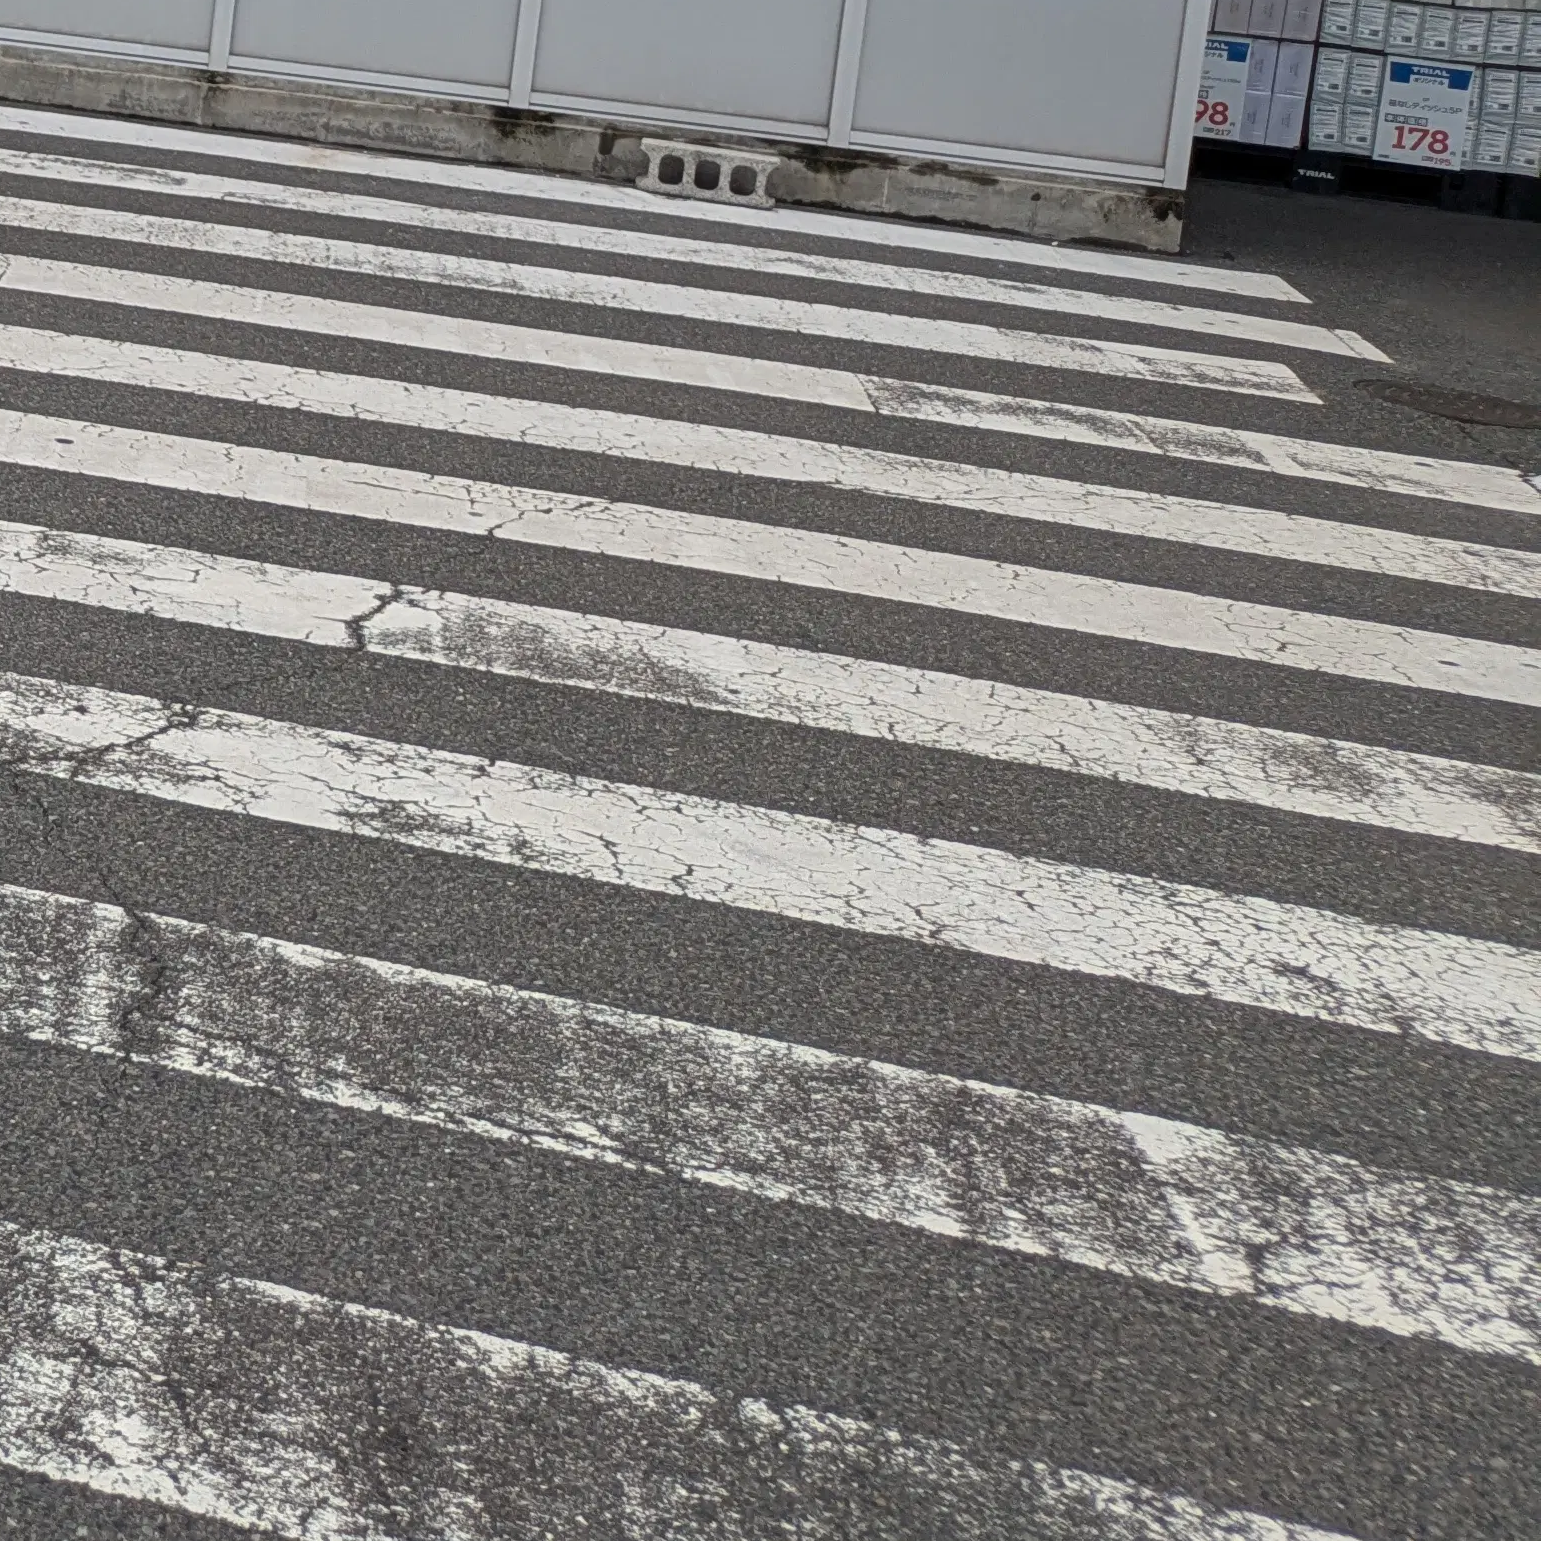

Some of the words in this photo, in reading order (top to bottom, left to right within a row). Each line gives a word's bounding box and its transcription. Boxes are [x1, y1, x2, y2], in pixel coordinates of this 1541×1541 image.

[1411, 66, 1450, 77] TRIAL
[1392, 125, 1450, 155] 178
[1297, 168, 1336, 180] TRIAL
